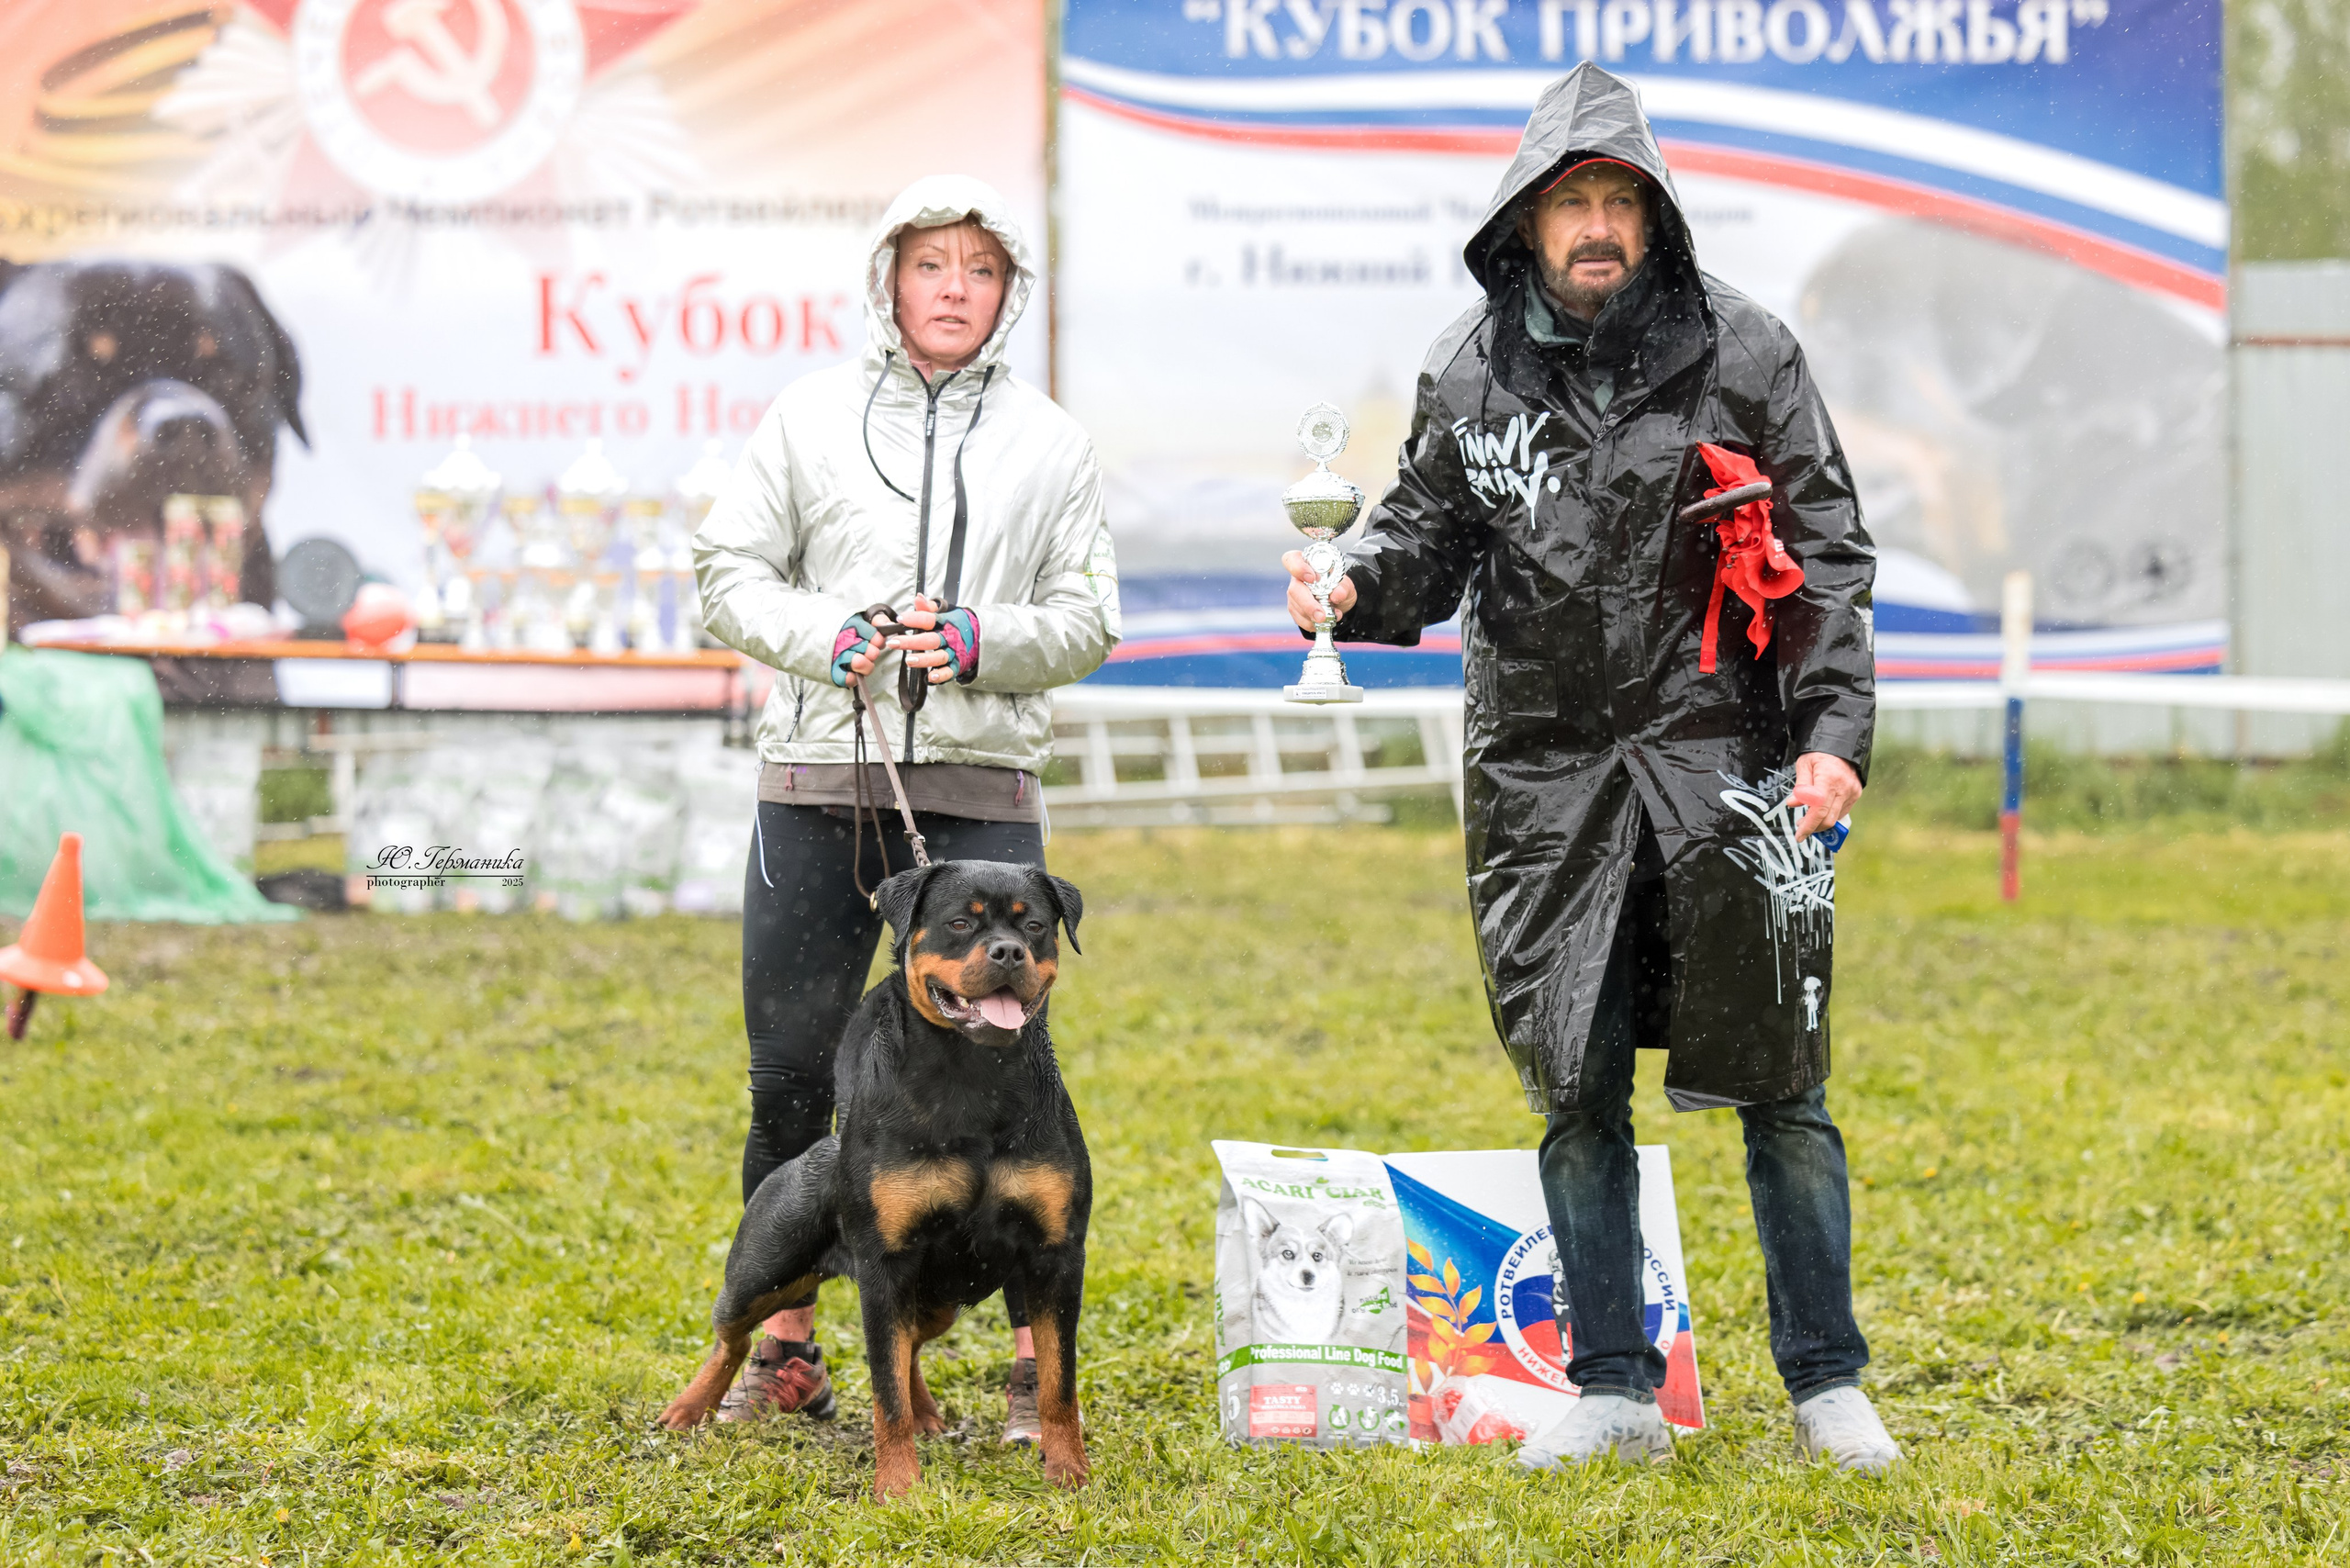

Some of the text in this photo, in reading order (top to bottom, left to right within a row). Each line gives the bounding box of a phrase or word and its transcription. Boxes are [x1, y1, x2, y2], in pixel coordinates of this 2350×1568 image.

[535, 273, 847, 379] Кубок
[1642, 1248, 1676, 1311] ОССИИ
[1325, 1346, 1351, 1361] Line
[1353, 1349, 1376, 1367] Dog
[1378, 1351, 1404, 1369] Food
[1263, 1395, 1302, 1405] TASTY
